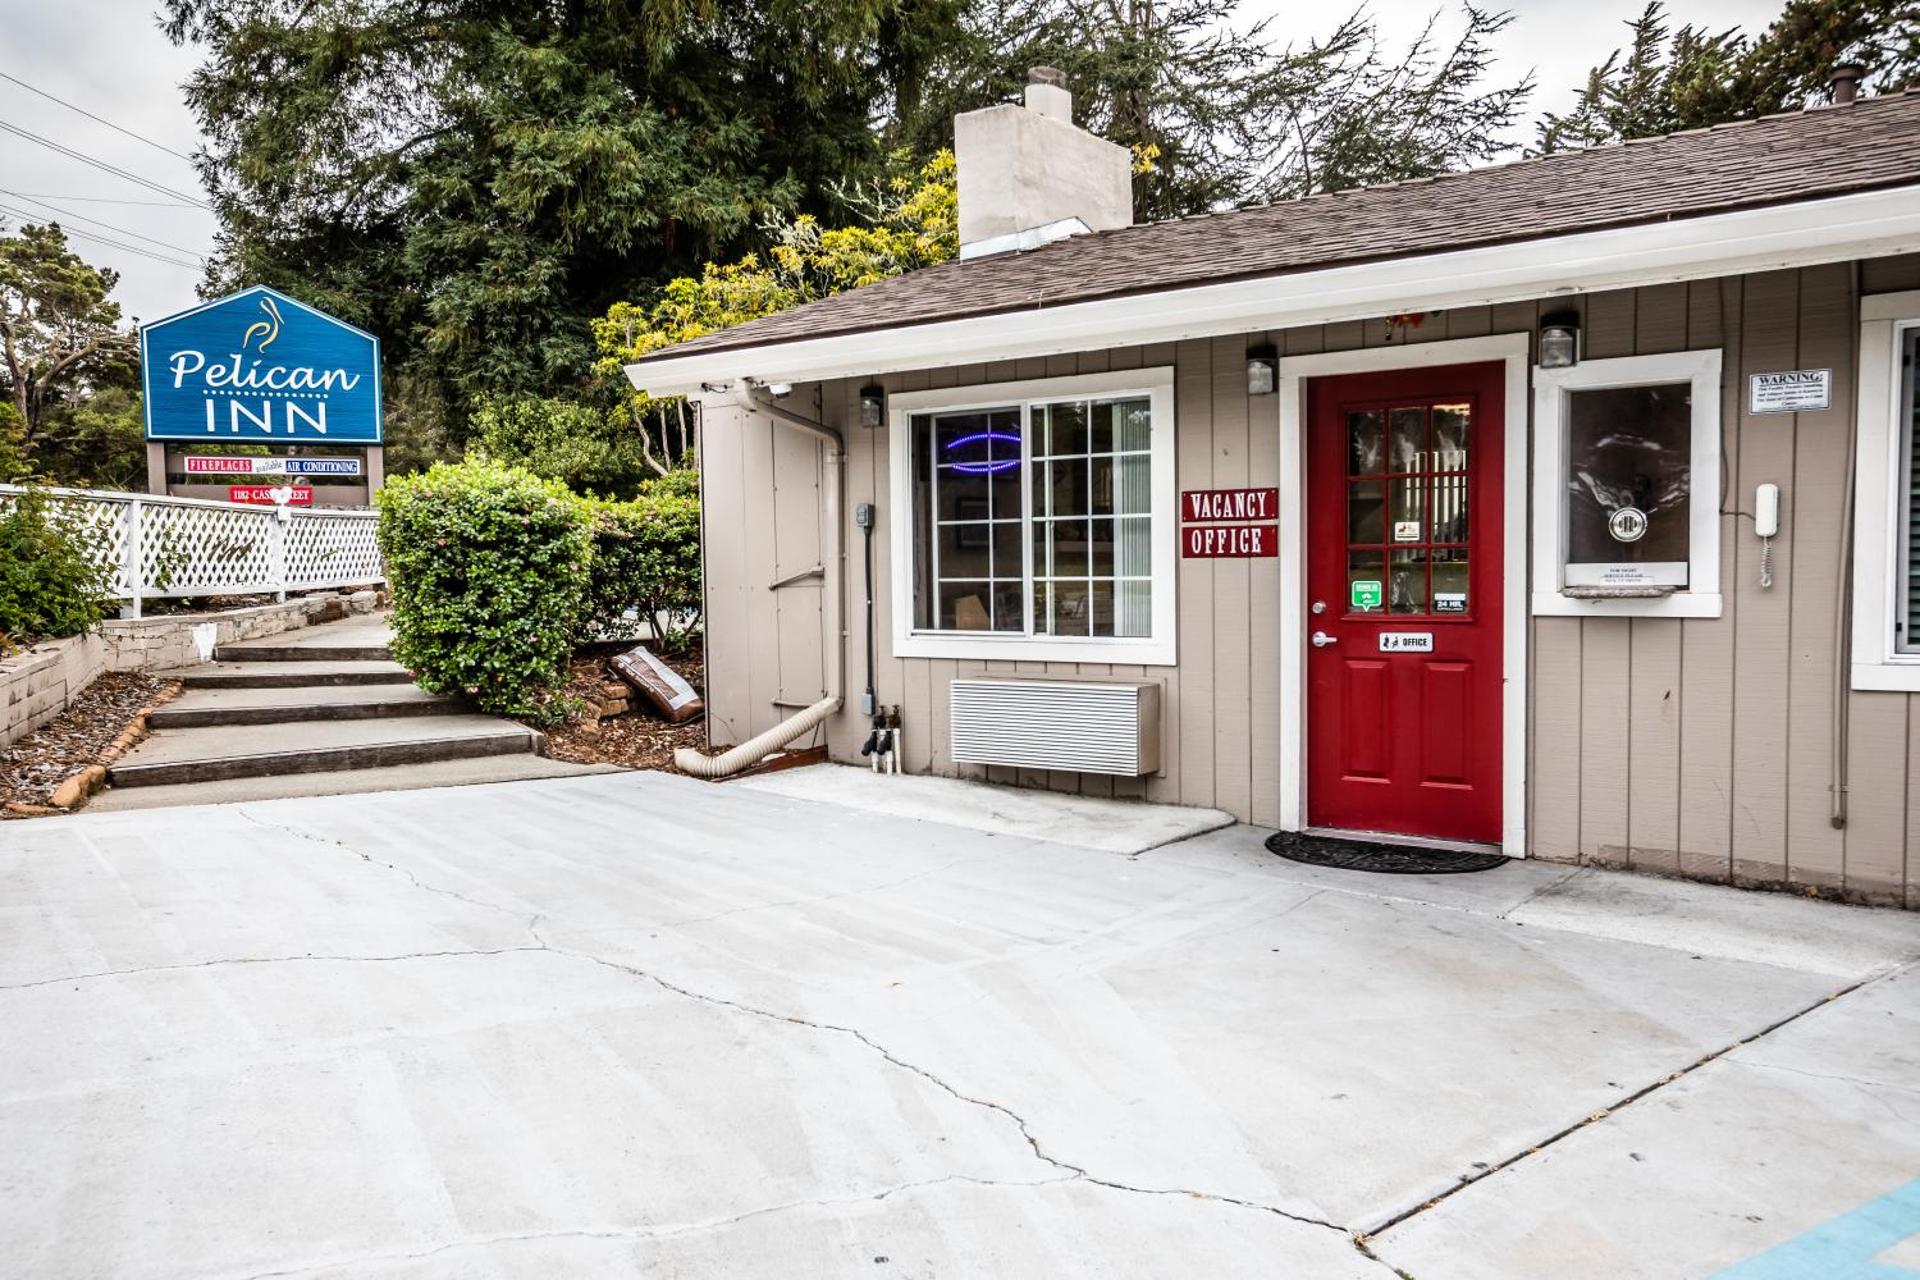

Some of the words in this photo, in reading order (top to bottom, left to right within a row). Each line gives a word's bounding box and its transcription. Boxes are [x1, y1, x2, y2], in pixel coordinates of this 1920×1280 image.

[169, 350, 361, 391] Pelican
[205, 399, 328, 434] INN
[189, 458, 251, 472] FIREPLACES
[287, 460, 301, 472] AIR
[303, 461, 358, 473] CONDITIONING
[233, 490, 250, 500] 1182
[252, 489, 273, 500] CAS
[1190, 492, 1267, 519] VACANCY
[1191, 528, 1262, 554] OFFICE
[1402, 637, 1428, 647] OFFICE
